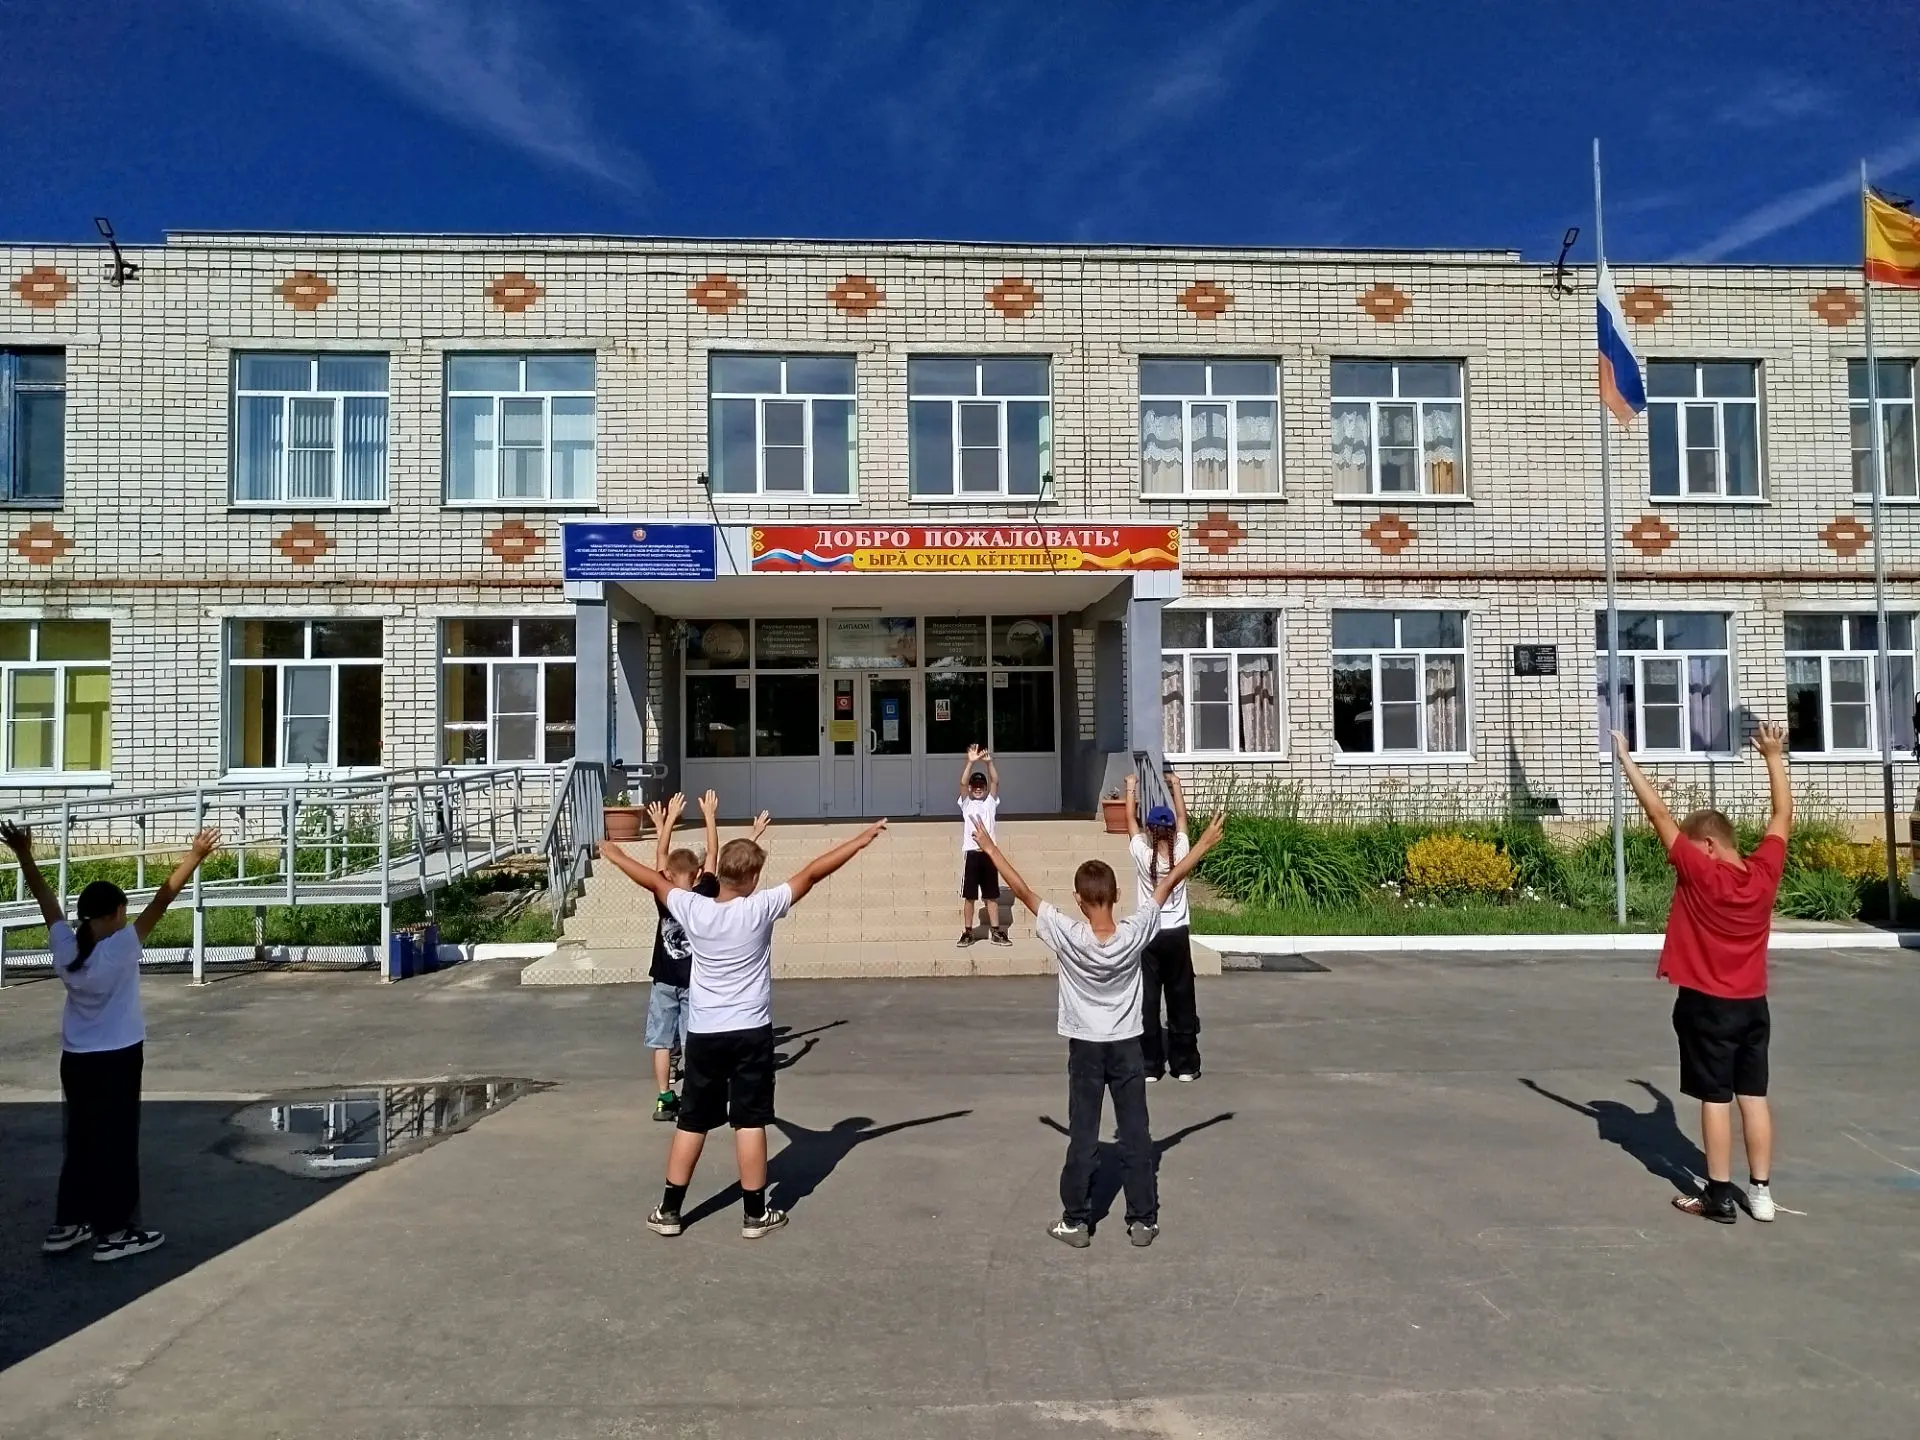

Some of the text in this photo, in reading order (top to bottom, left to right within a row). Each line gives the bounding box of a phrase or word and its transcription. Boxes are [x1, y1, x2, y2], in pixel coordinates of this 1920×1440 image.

[814, 530, 1120, 551] ДОБРО ПОЖАЛОВАТЬ!
[914, 553, 971, 566] СУНСА
